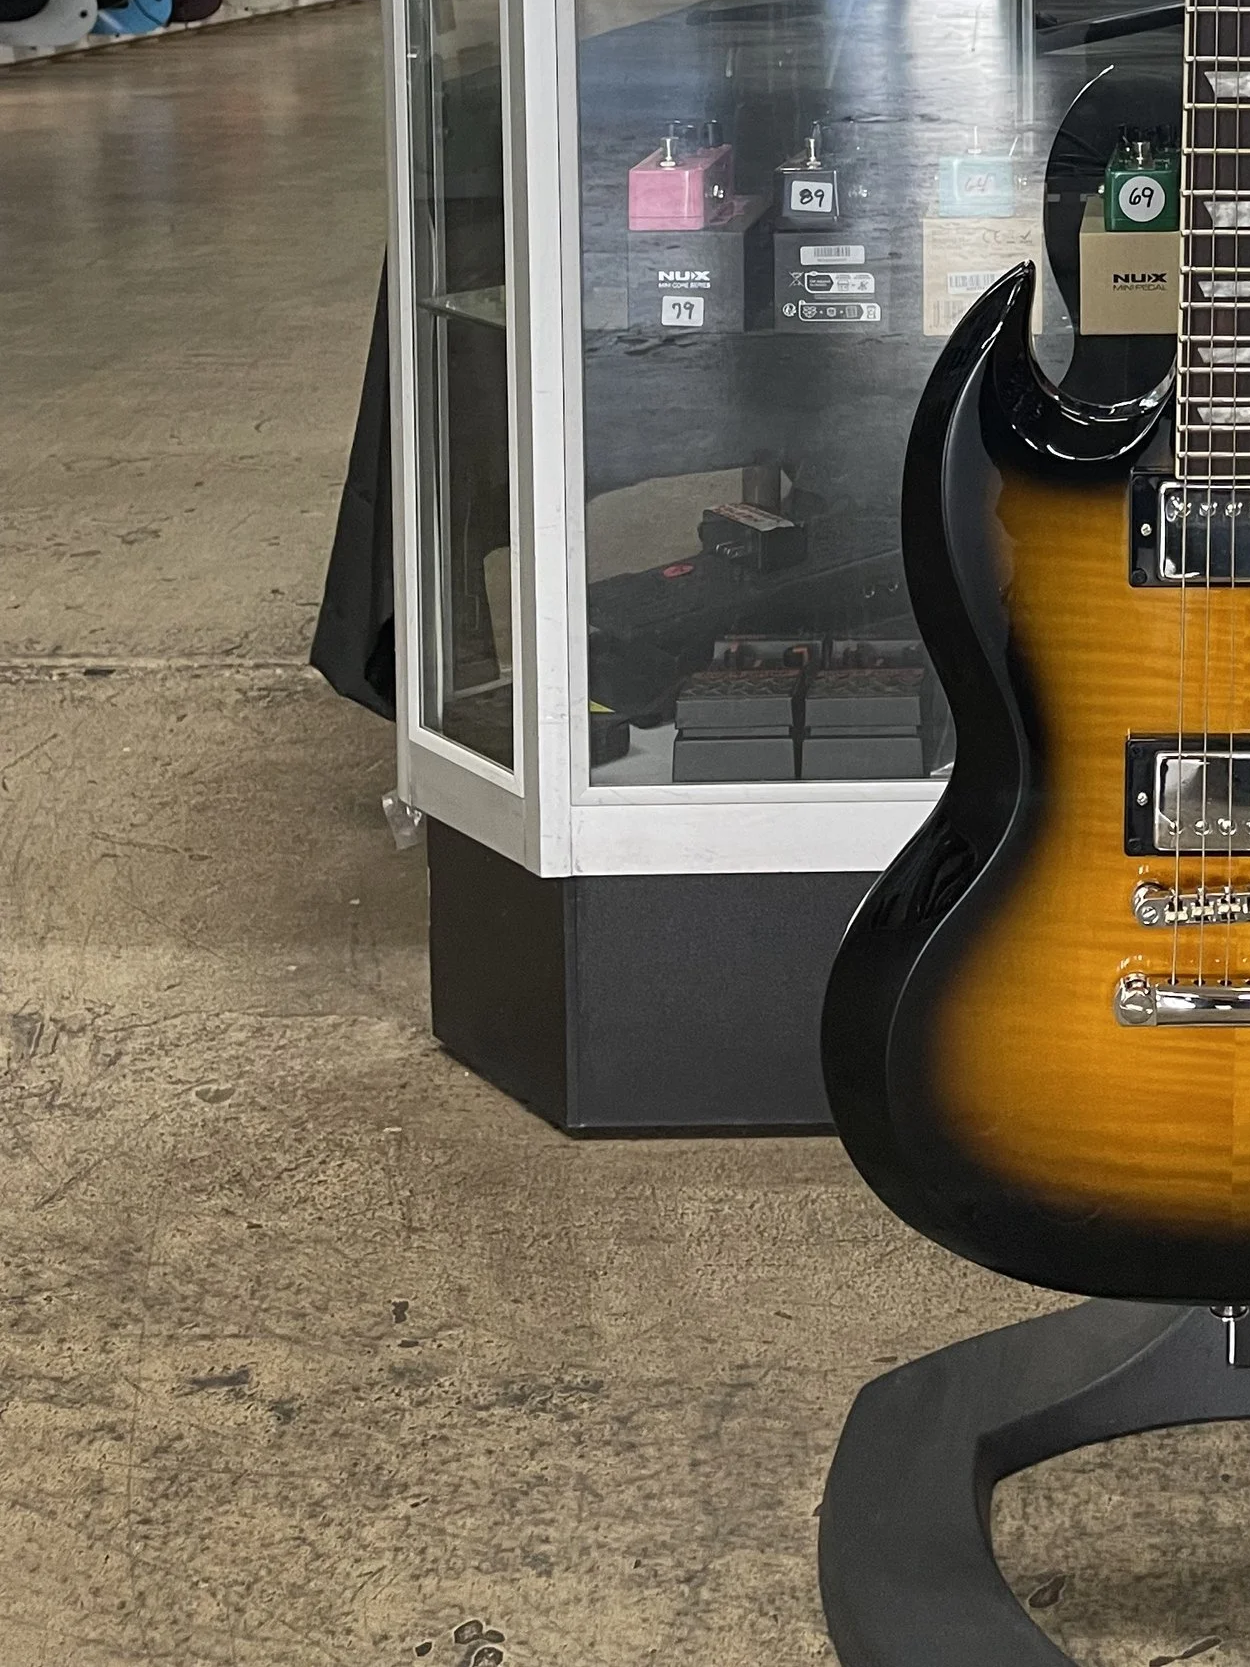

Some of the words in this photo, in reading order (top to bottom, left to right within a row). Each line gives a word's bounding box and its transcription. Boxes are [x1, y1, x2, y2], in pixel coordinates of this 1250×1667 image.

[799, 188, 825, 208] 89
[1128, 186, 1154, 208] 69
[658, 271, 711, 281] NUX
[1113, 273, 1168, 283] NUX
[671, 301, 695, 320] 79
